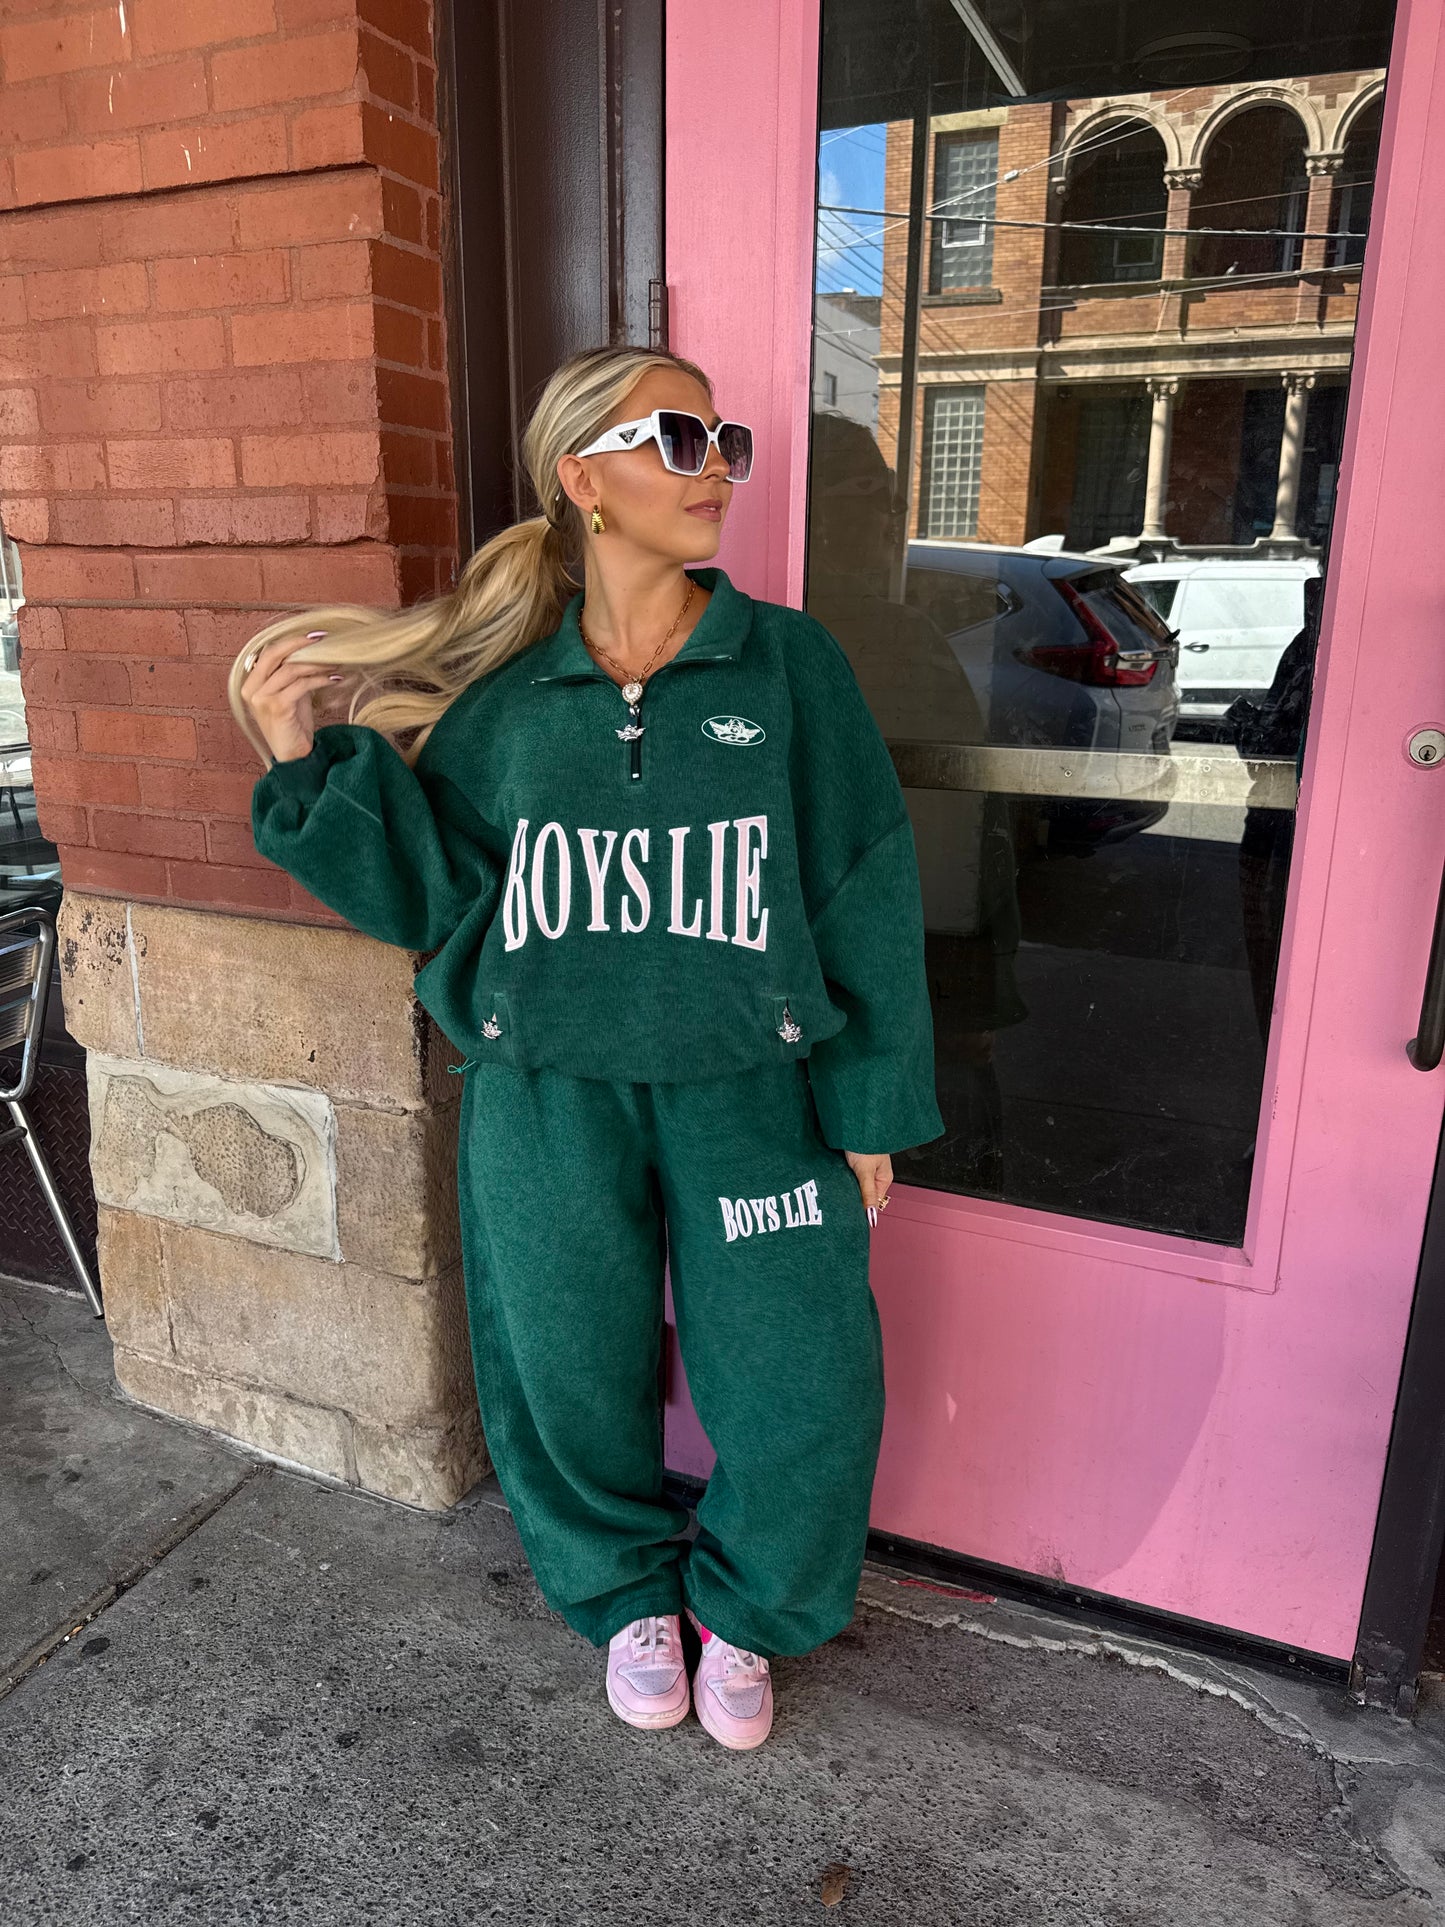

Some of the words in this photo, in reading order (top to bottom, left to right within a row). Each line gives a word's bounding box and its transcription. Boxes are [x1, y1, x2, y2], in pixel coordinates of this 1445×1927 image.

[503, 818, 650, 952] BOYS
[667, 815, 769, 952] LIE
[718, 1197, 780, 1243] BOYS
[780, 1179, 822, 1228] LIE
